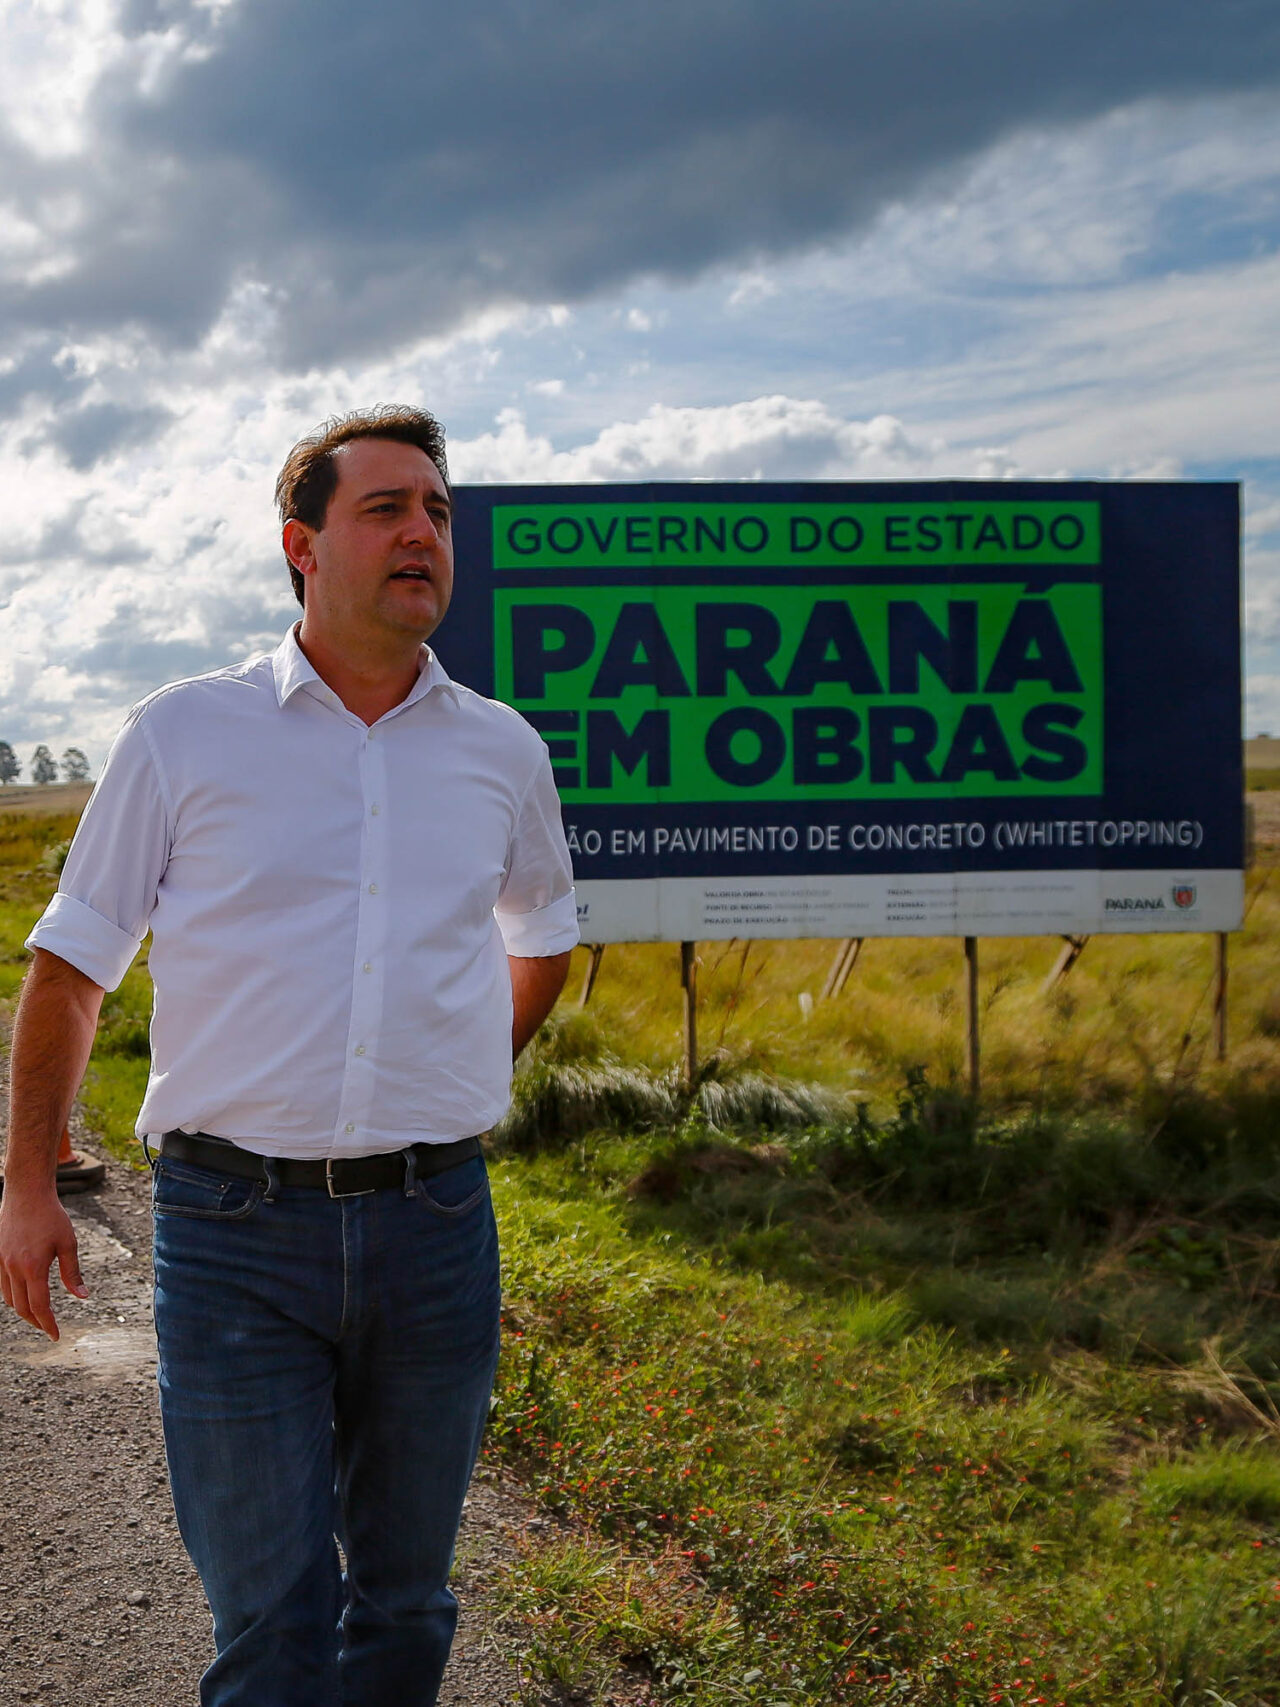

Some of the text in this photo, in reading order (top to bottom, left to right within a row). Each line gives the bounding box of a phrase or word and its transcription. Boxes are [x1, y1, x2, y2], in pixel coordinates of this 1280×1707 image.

[507, 513, 1085, 555] GOVERNO DO ESTADO
[511, 584, 1085, 699] PARANÁ
[521, 702, 1088, 790] EM OBRAS
[611, 828, 647, 856] EM
[654, 826, 800, 856] PAVIMENTO
[807, 825, 841, 852] DE
[849, 821, 987, 851] CONCRETO
[993, 820, 1204, 850] (WHITETOPPING)
